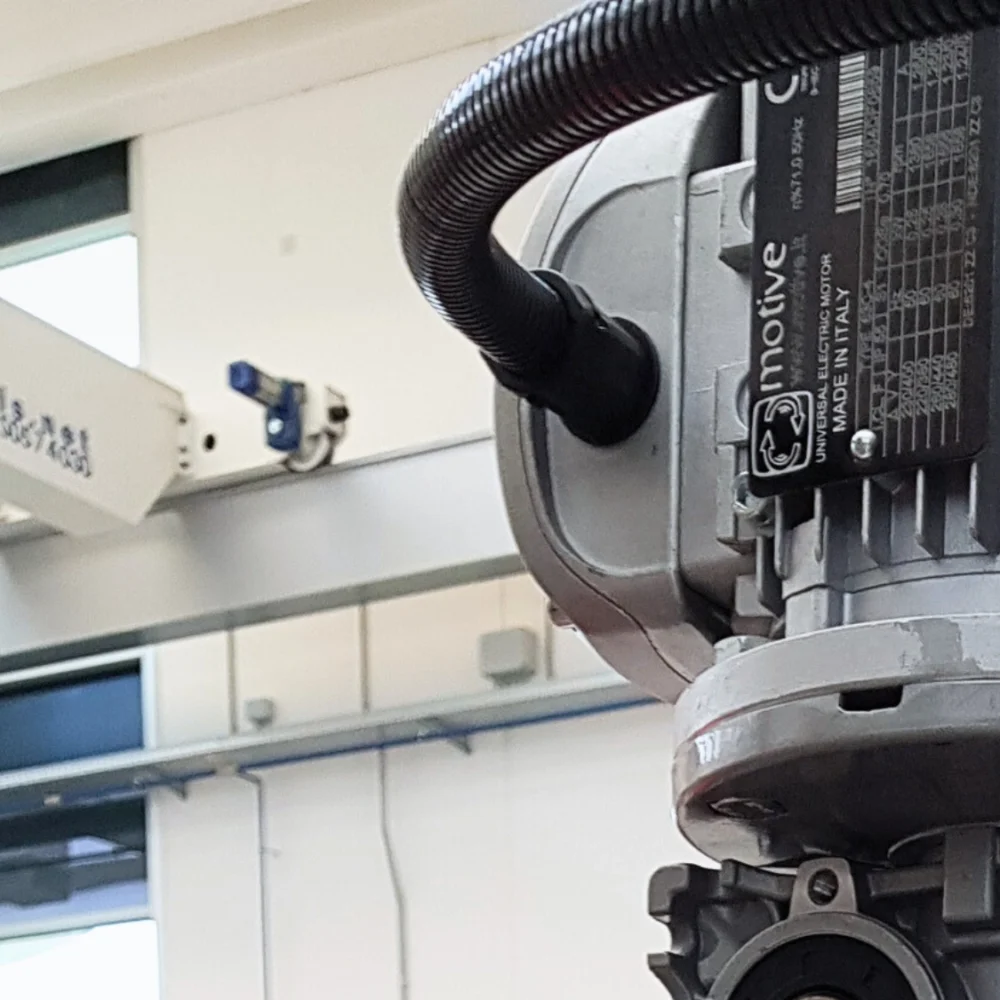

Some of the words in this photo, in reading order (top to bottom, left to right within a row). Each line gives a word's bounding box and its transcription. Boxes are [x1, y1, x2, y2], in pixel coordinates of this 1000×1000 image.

[820, 251, 832, 307] MOTOR
[756, 241, 787, 392] motive
[834, 286, 851, 342] ITALY
[817, 309, 831, 380] ELECTRIC
[833, 347, 849, 368] IN
[815, 382, 828, 463] UNIVERSAL
[832, 373, 848, 432] MADE
